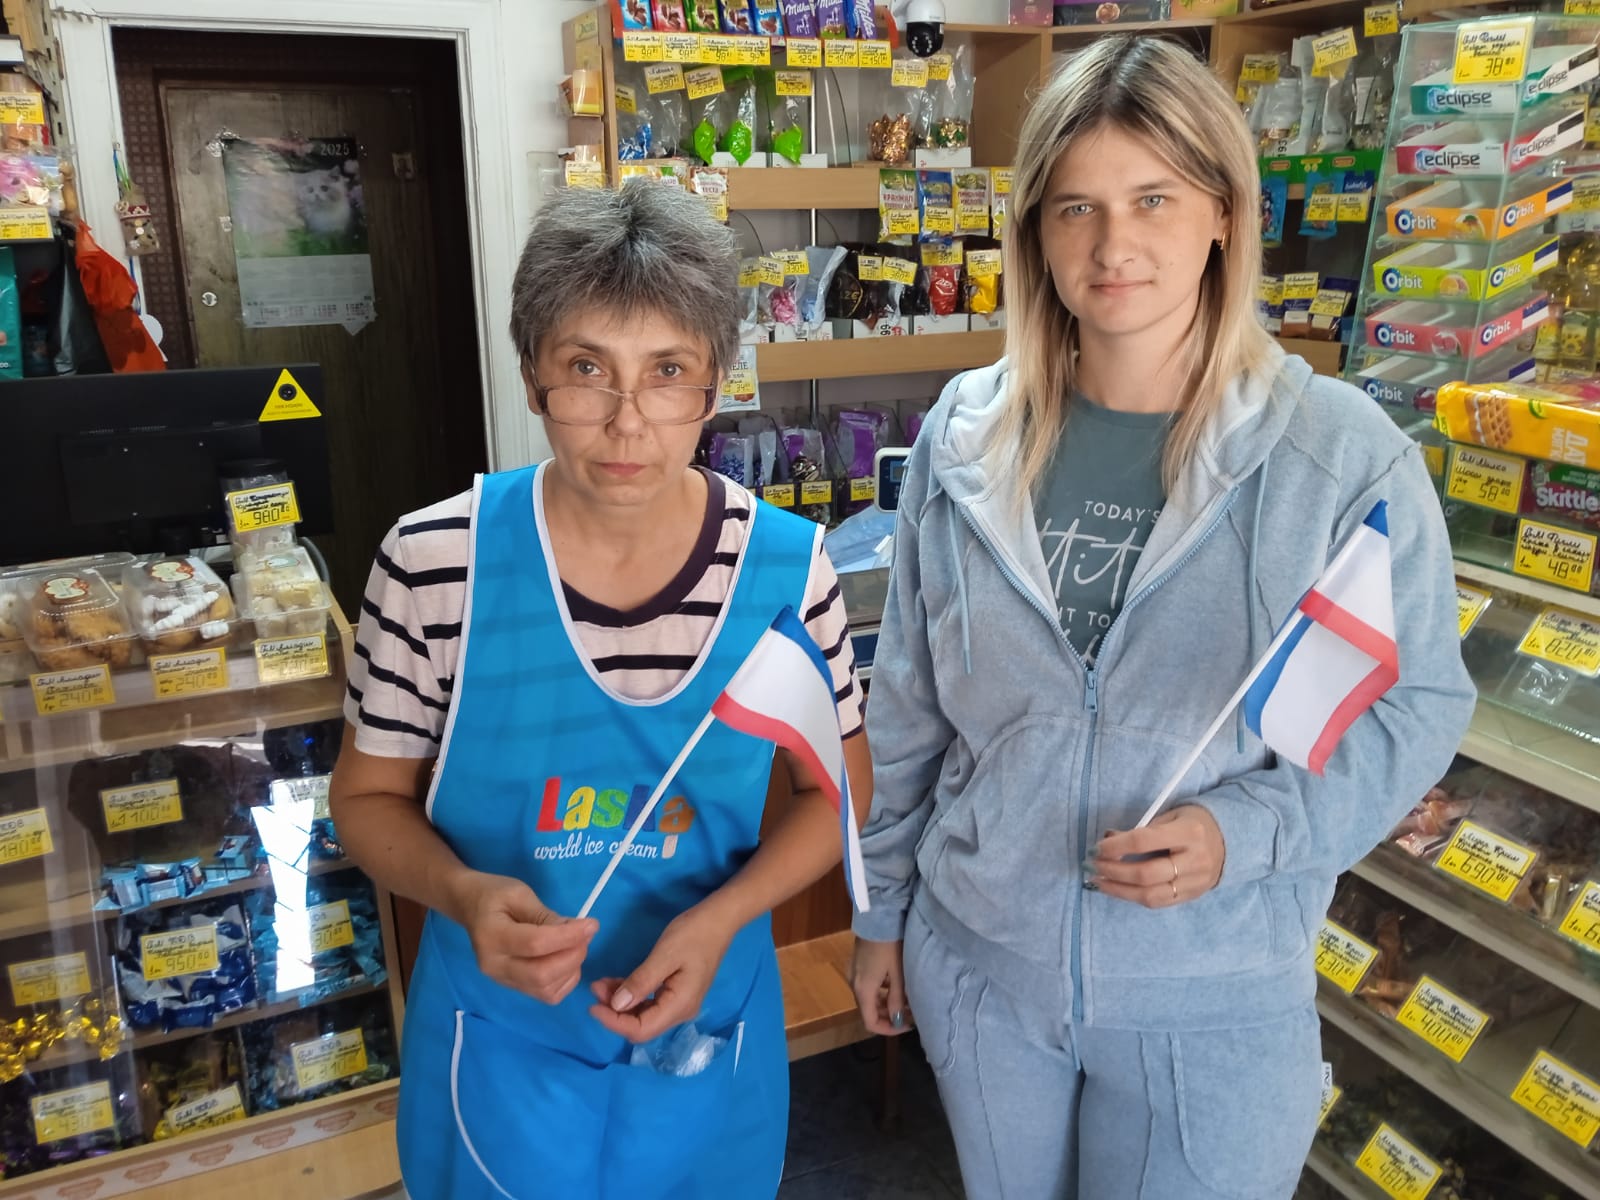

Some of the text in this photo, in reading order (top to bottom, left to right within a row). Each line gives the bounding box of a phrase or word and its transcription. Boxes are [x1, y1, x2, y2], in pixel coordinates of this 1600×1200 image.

[785, 2, 813, 16] Milka
[1484, 57, 1504, 78] 38
[1529, 70, 1568, 95] eclipse
[1436, 91, 1492, 108] eclipse
[320, 143, 350, 156] 2025
[1519, 134, 1557, 157] eclipse
[1424, 151, 1481, 168] eclipse
[1397, 211, 1436, 232] Orbit
[1504, 203, 1534, 227] Orbit
[1384, 270, 1422, 291] Orbit
[1492, 265, 1521, 286] Orbit
[1377, 325, 1415, 346] Orbit
[1482, 321, 1511, 344] Orbit
[731, 361, 749, 371] ЕЛЕ
[1365, 379, 1404, 402] Orbit
[1564, 430, 1589, 468] ДАТ
[1478, 485, 1498, 503] 58
[1536, 486, 1600, 512] Skittle
[253, 509, 280, 527] 980
[1084, 500, 1162, 524] TODAY'S
[1547, 560, 1569, 579] 48
[1087, 611, 1112, 629] TO
[534, 831, 659, 861] world ice ceam
[1460, 855, 1496, 885] 690
[165, 954, 197, 974] 950
[1535, 1093, 1572, 1127] 625
